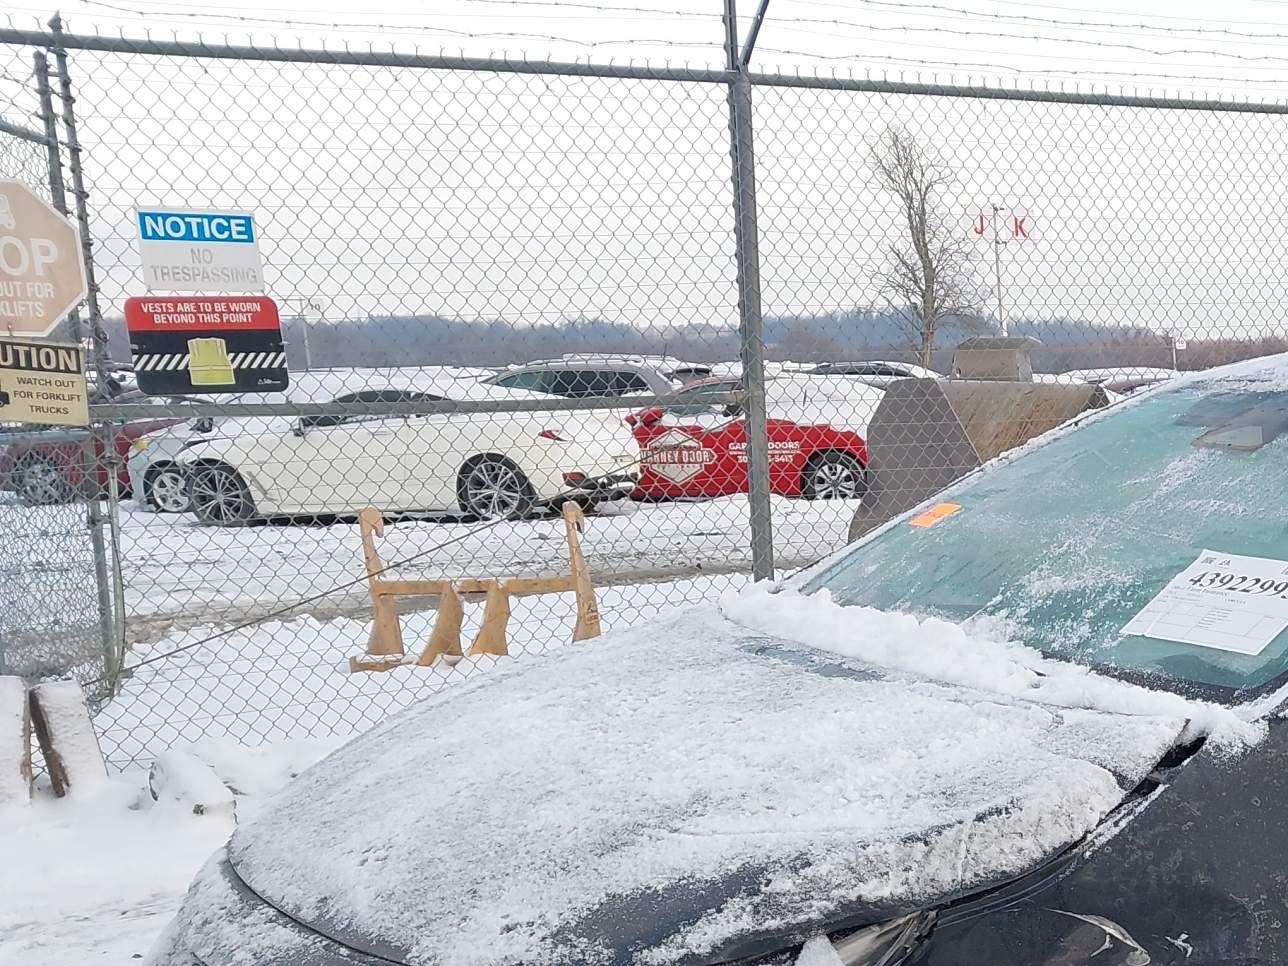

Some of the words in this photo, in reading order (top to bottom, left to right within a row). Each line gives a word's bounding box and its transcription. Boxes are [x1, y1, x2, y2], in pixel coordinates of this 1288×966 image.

[145, 216, 248, 240] NOTICE
[974, 216, 984, 234] J
[1014, 216, 1027, 238] K
[0, 235, 58, 276] OP
[190, 247, 213, 264] NO
[150, 265, 257, 284] TRESPASSING
[26, 282, 55, 299] FOR
[141, 302, 174, 313] VESTS
[177, 302, 197, 313] ARE
[198, 303, 212, 313] TO
[214, 303, 227, 312] BE
[229, 303, 261, 313] WORN
[154, 313, 196, 323] BEYOND
[198, 313, 221, 323] THIS
[223, 313, 253, 323] POINT
[0, 344, 77, 371] UTION
[17, 377, 52, 387] WATCH
[55, 379, 76, 389] OUT
[14, 390, 33, 399] FOR
[36, 391, 81, 402] FORKLIFT
[30, 404, 69, 415] TRUCKS
[767, 441, 800, 450] DOORS
